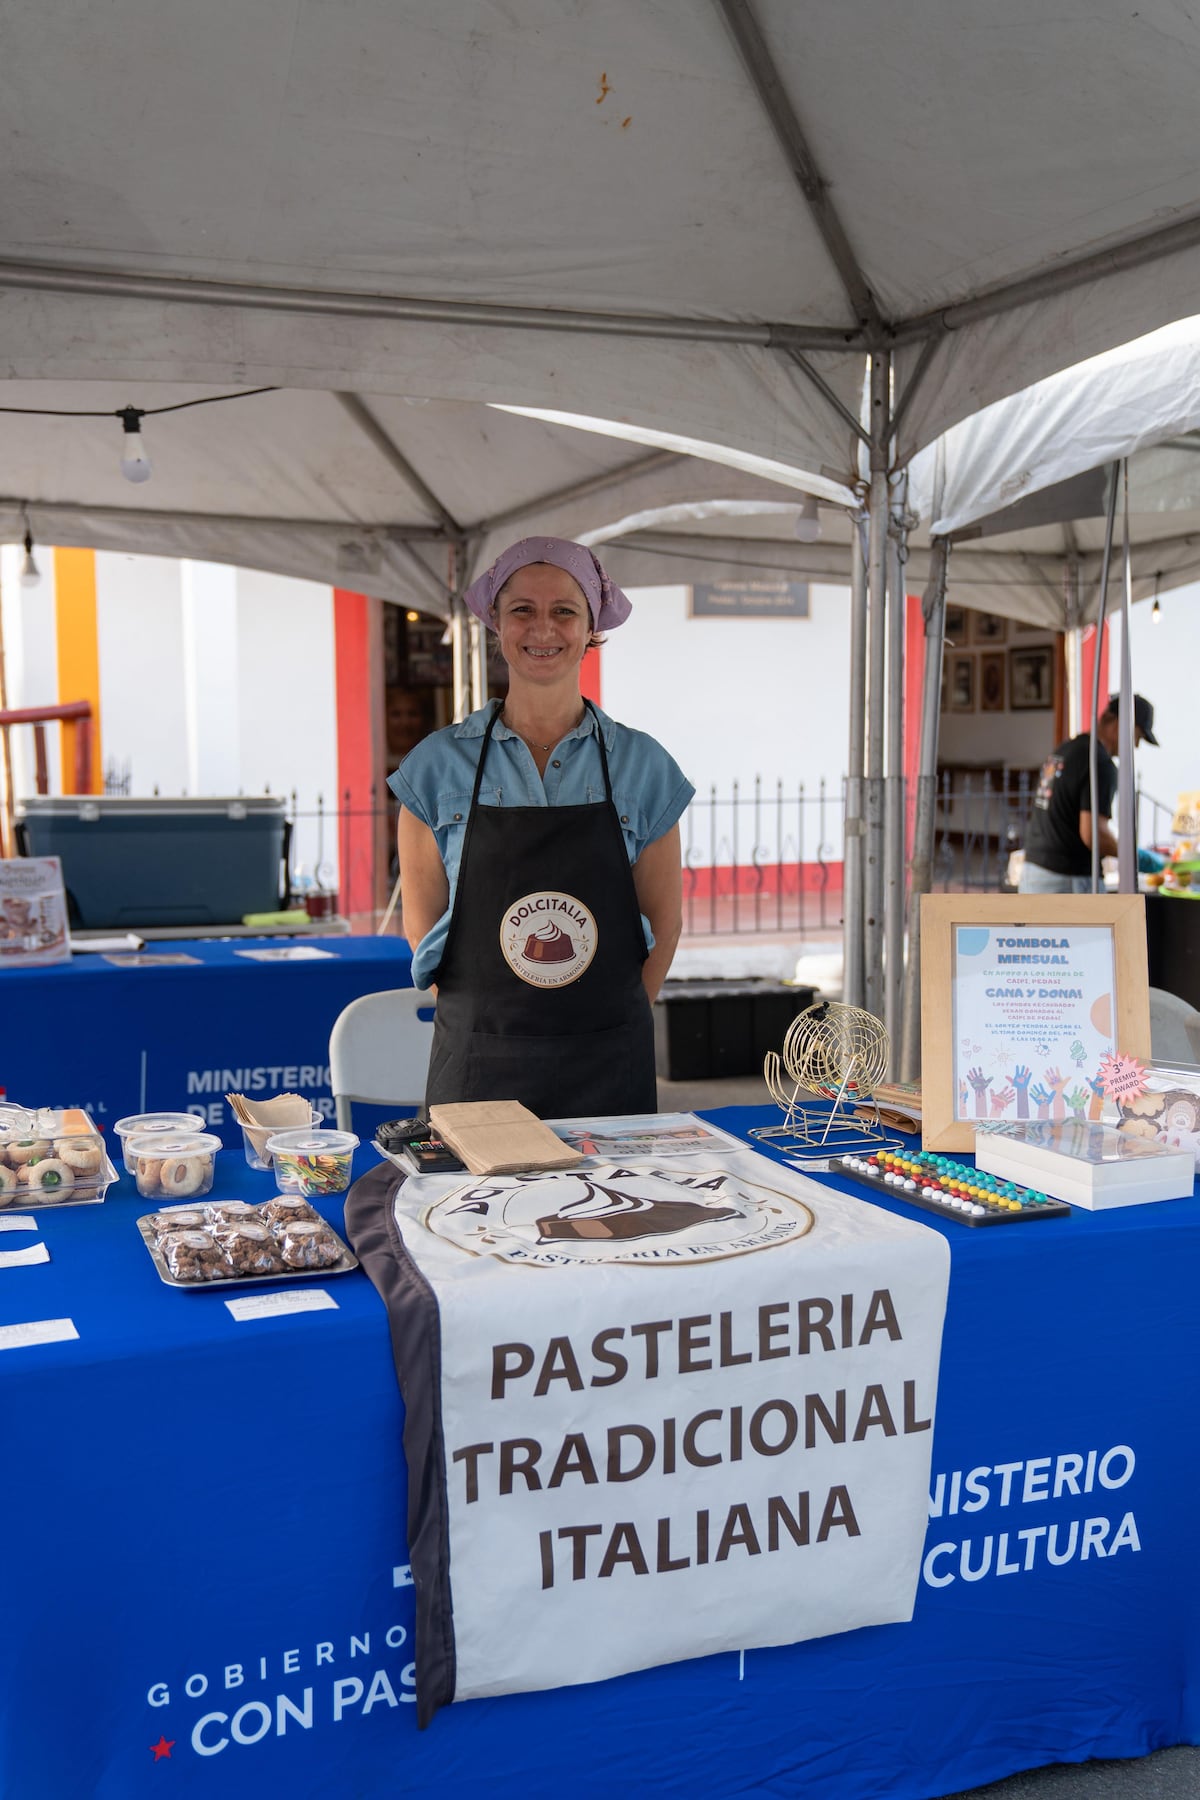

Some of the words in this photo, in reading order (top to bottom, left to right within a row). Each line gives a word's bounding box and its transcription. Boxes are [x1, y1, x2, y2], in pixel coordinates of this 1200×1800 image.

[509, 899, 587, 928] DOLCITALIA
[996, 938, 1070, 948] TOMBOLA
[998, 954, 1069, 964] MENSUAL
[985, 988, 1024, 998] GANA
[1026, 988, 1036, 998] Y
[1110, 1071, 1137, 1086] PREMIO
[1114, 1080, 1139, 1094] AWARD
[490, 1289, 903, 1399] PASTELERIA
[452, 1379, 932, 1504] TRADICIONAL
[538, 1485, 861, 1590] ITALIANA
[922, 1512, 1141, 1588] CULTURA
[147, 1625, 407, 1707] GOBIERNO
[191, 1687, 314, 1757] CON
